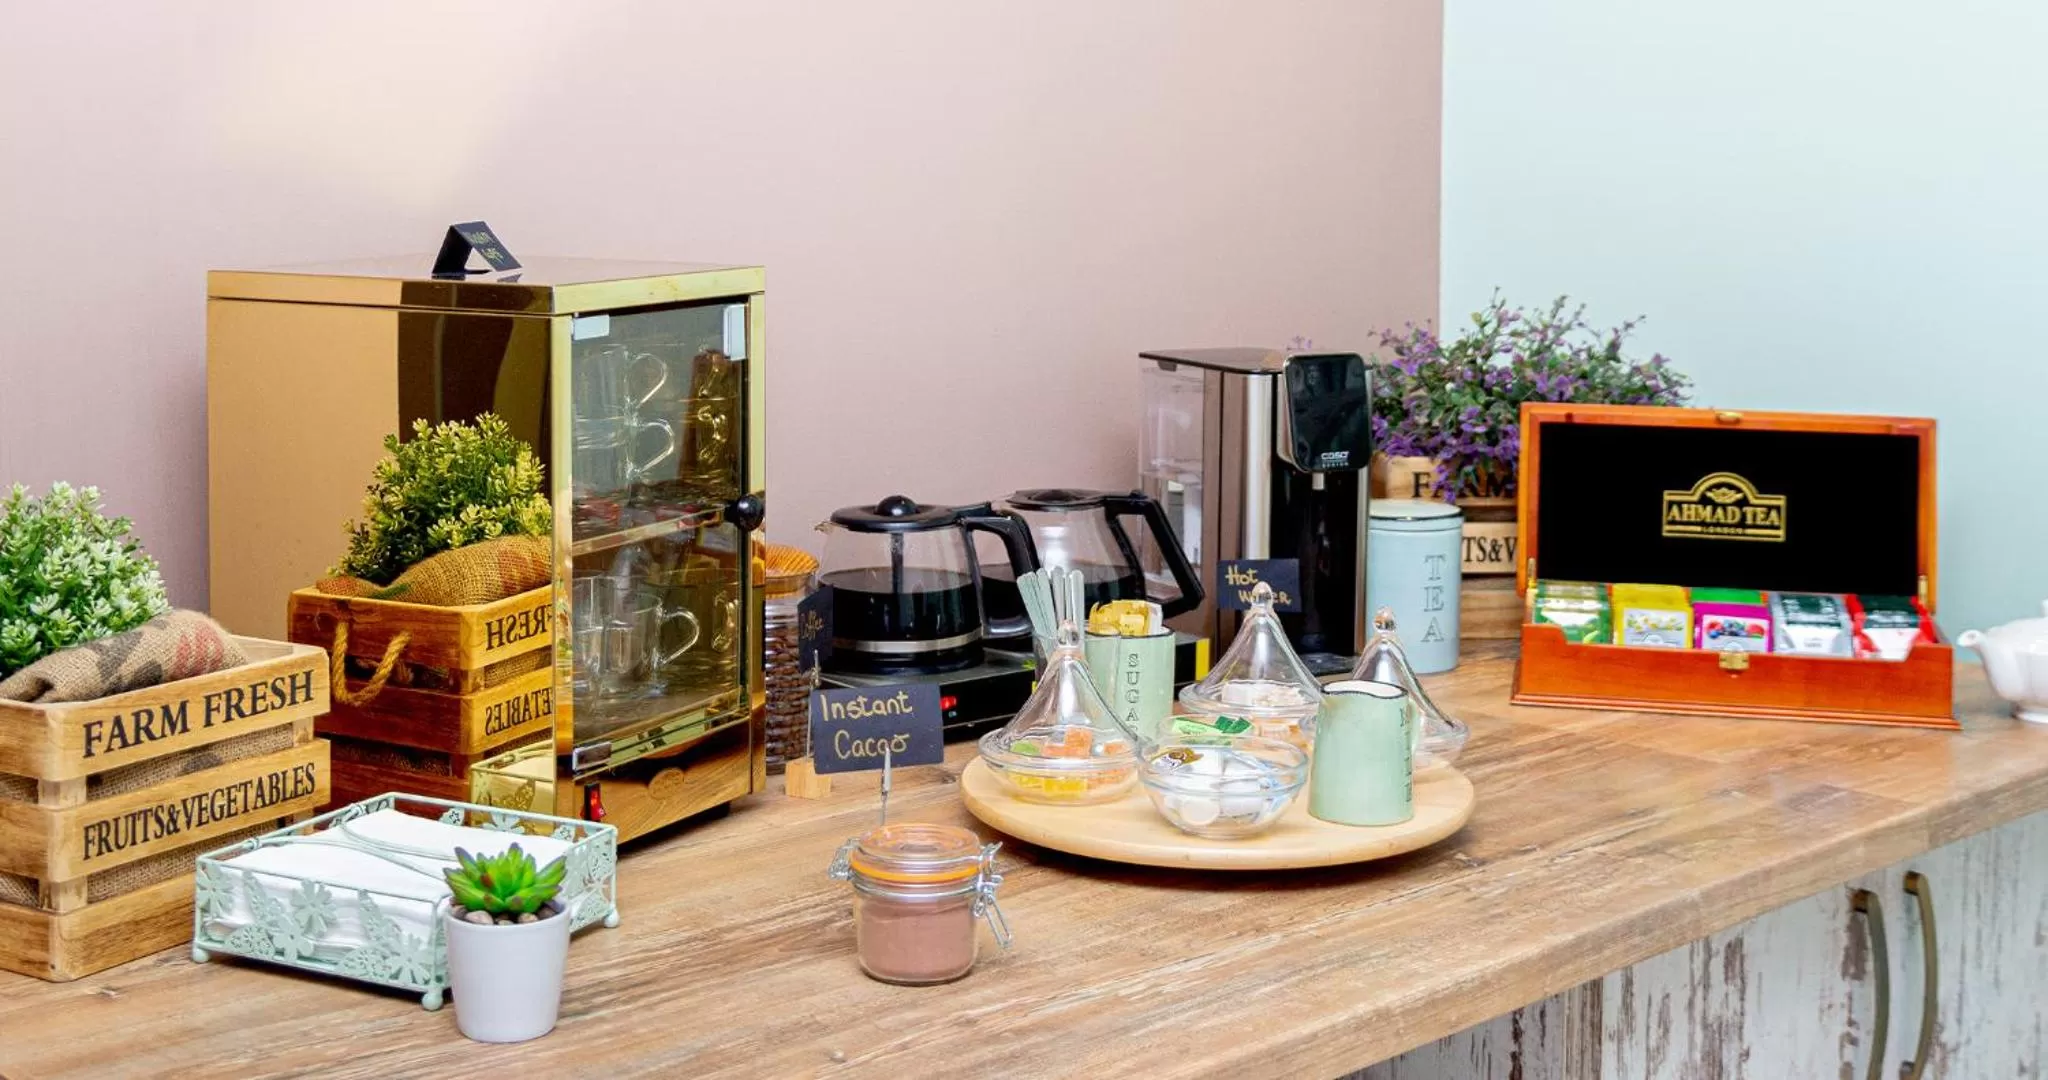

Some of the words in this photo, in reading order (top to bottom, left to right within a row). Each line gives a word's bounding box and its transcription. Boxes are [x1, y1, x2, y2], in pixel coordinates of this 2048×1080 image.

[1668, 504, 1741, 525] AHMAD
[1742, 506, 1780, 526] TEA
[1225, 564, 1258, 585] Hot
[1420, 554, 1447, 643] TEA
[83, 700, 191, 758] FARM
[203, 670, 315, 728] FRESH
[820, 691, 913, 721] Instant
[834, 729, 910, 759] Cacao
[83, 763, 315, 860] FRUITS&VEGETABLES
